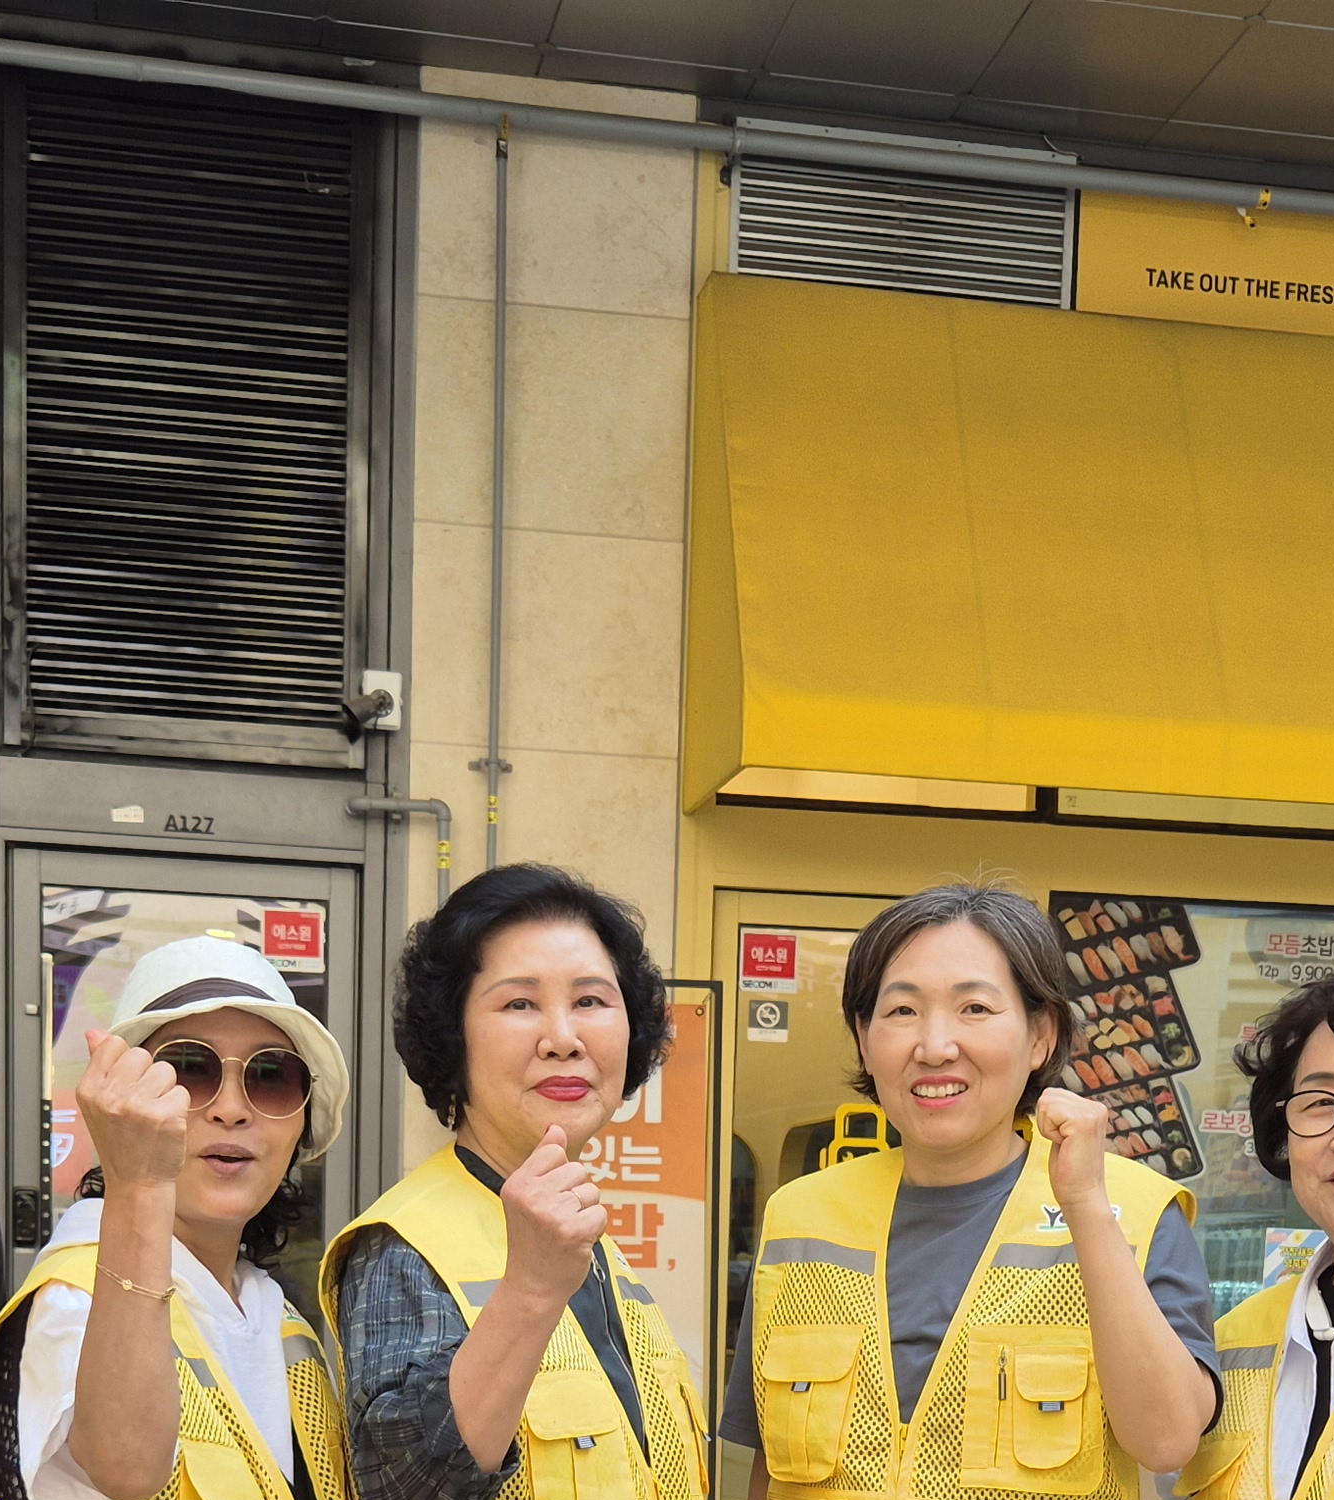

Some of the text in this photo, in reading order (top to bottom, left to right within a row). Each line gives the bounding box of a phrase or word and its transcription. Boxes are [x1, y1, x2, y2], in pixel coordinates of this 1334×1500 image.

[1145, 267, 1195, 293] TAKE
[1198, 272, 1239, 298] OUT
[1243, 276, 1281, 302] THE
[164, 814, 215, 834] A127
[272, 924, 312, 942] 에스원
[750, 946, 788, 964] 에스원
[1258, 964, 1279, 980] 12p
